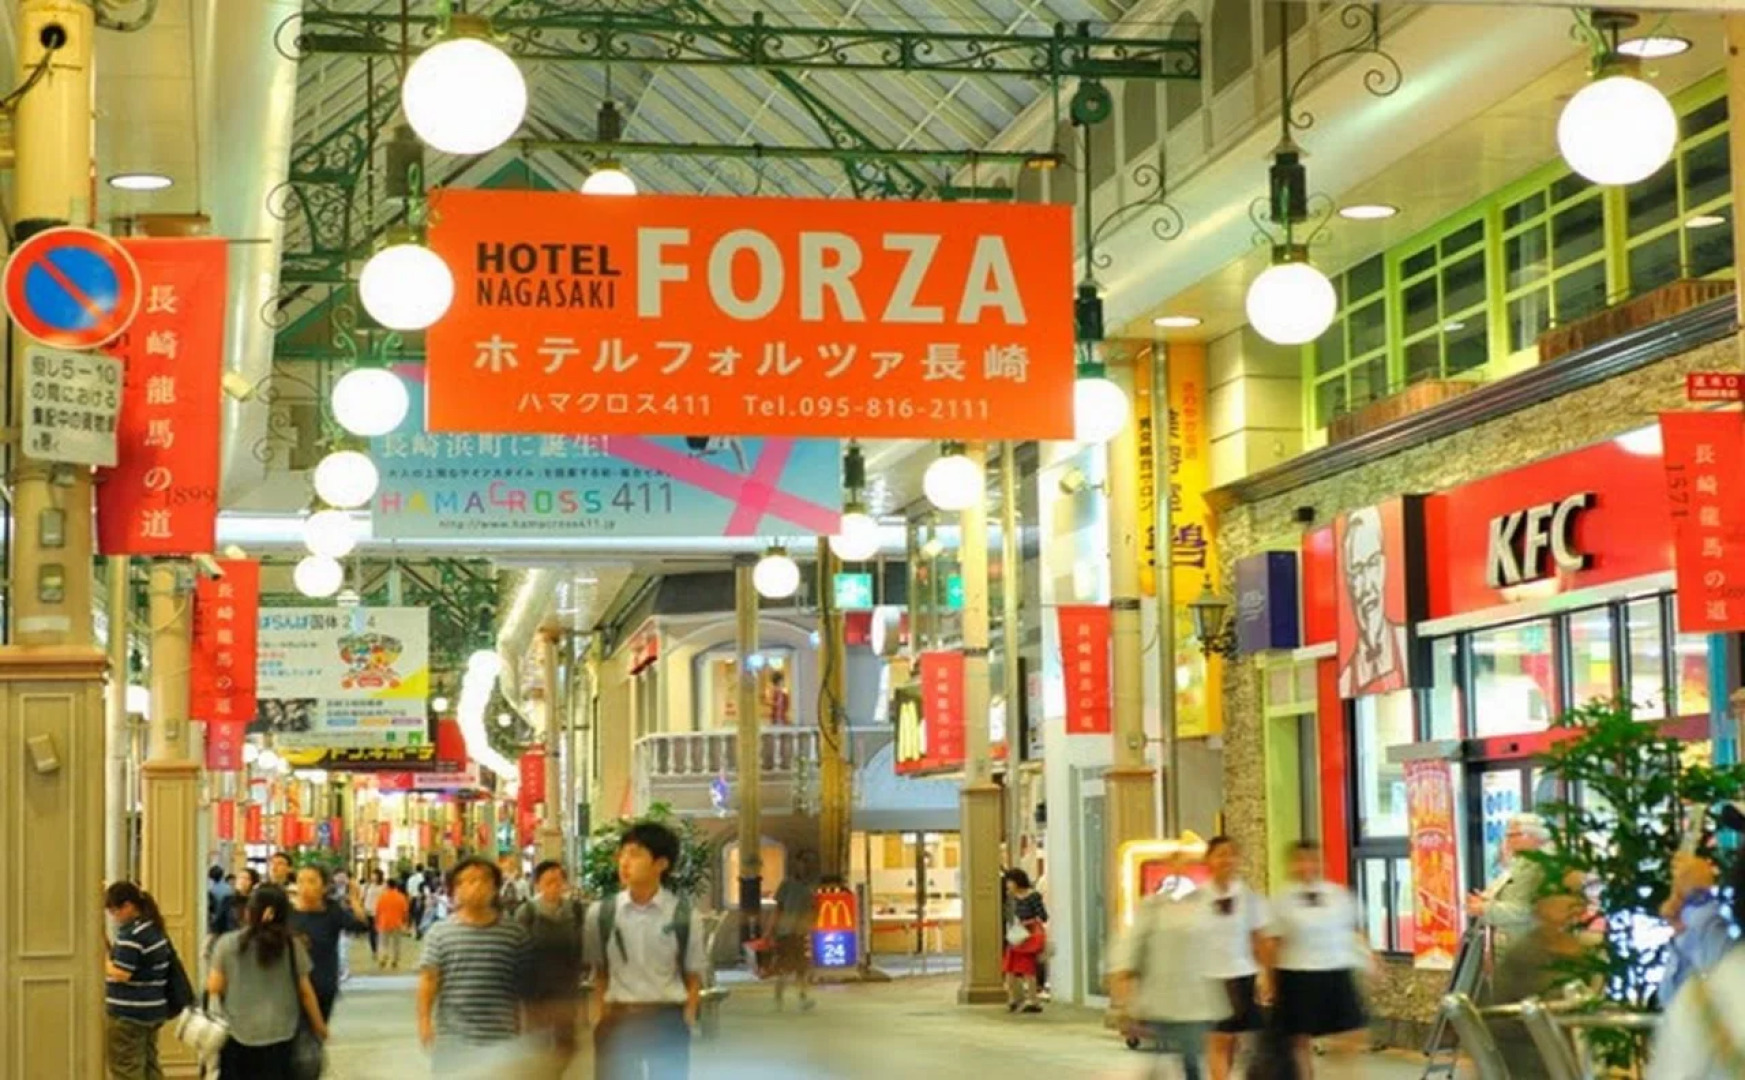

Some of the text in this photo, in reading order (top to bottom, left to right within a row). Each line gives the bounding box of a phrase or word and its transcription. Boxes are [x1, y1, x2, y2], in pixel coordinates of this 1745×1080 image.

[476, 242, 621, 277] HOTEL
[635, 226, 1027, 325] FORZA
[476, 277, 616, 310] NAGASAKI
[474, 335, 1031, 385] ホテルフォルツァ長崎
[141, 284, 179, 540] 長崎龍馬の道
[517, 391, 989, 421] ハマクロス411 Tel.095-816-2111
[611, 481, 673, 514] 411
[1486, 492, 1594, 588] KFC
